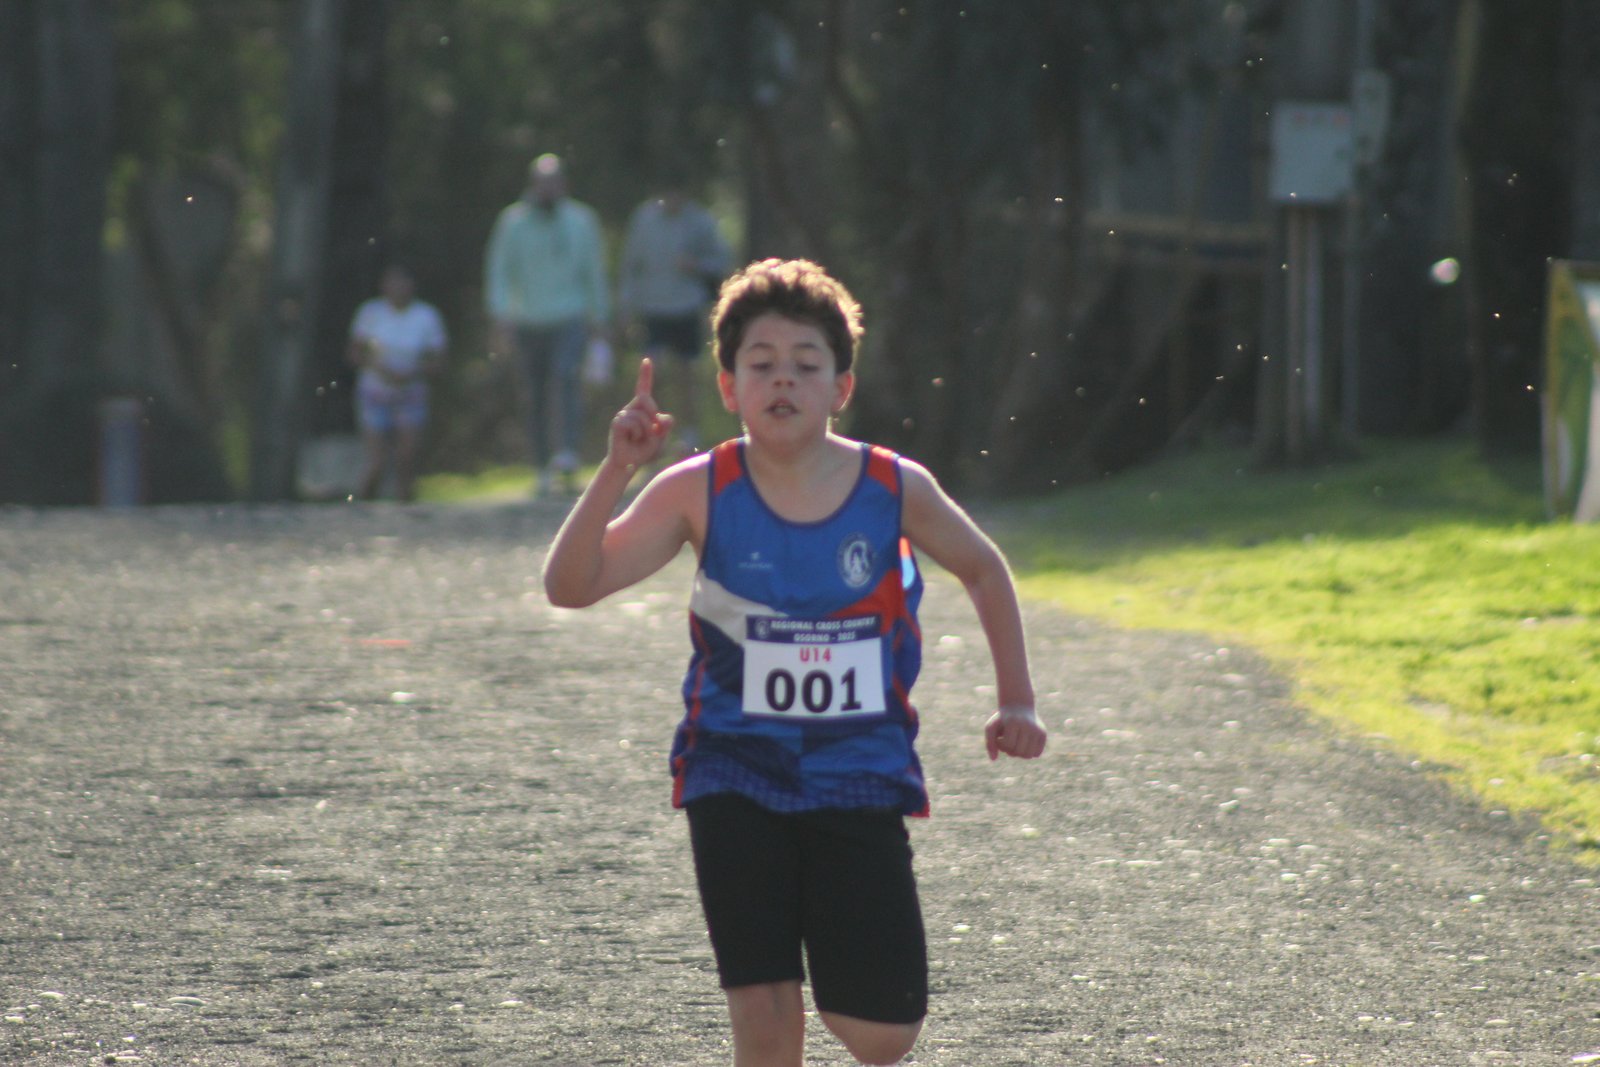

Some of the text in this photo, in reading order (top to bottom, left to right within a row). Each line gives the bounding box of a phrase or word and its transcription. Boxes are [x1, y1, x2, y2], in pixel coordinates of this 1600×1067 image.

[770, 616, 876, 630] REGIONAL CROSS COUNTRY
[793, 633, 830, 642] OSORNO
[800, 647, 832, 662] U14
[765, 667, 862, 713] 001
